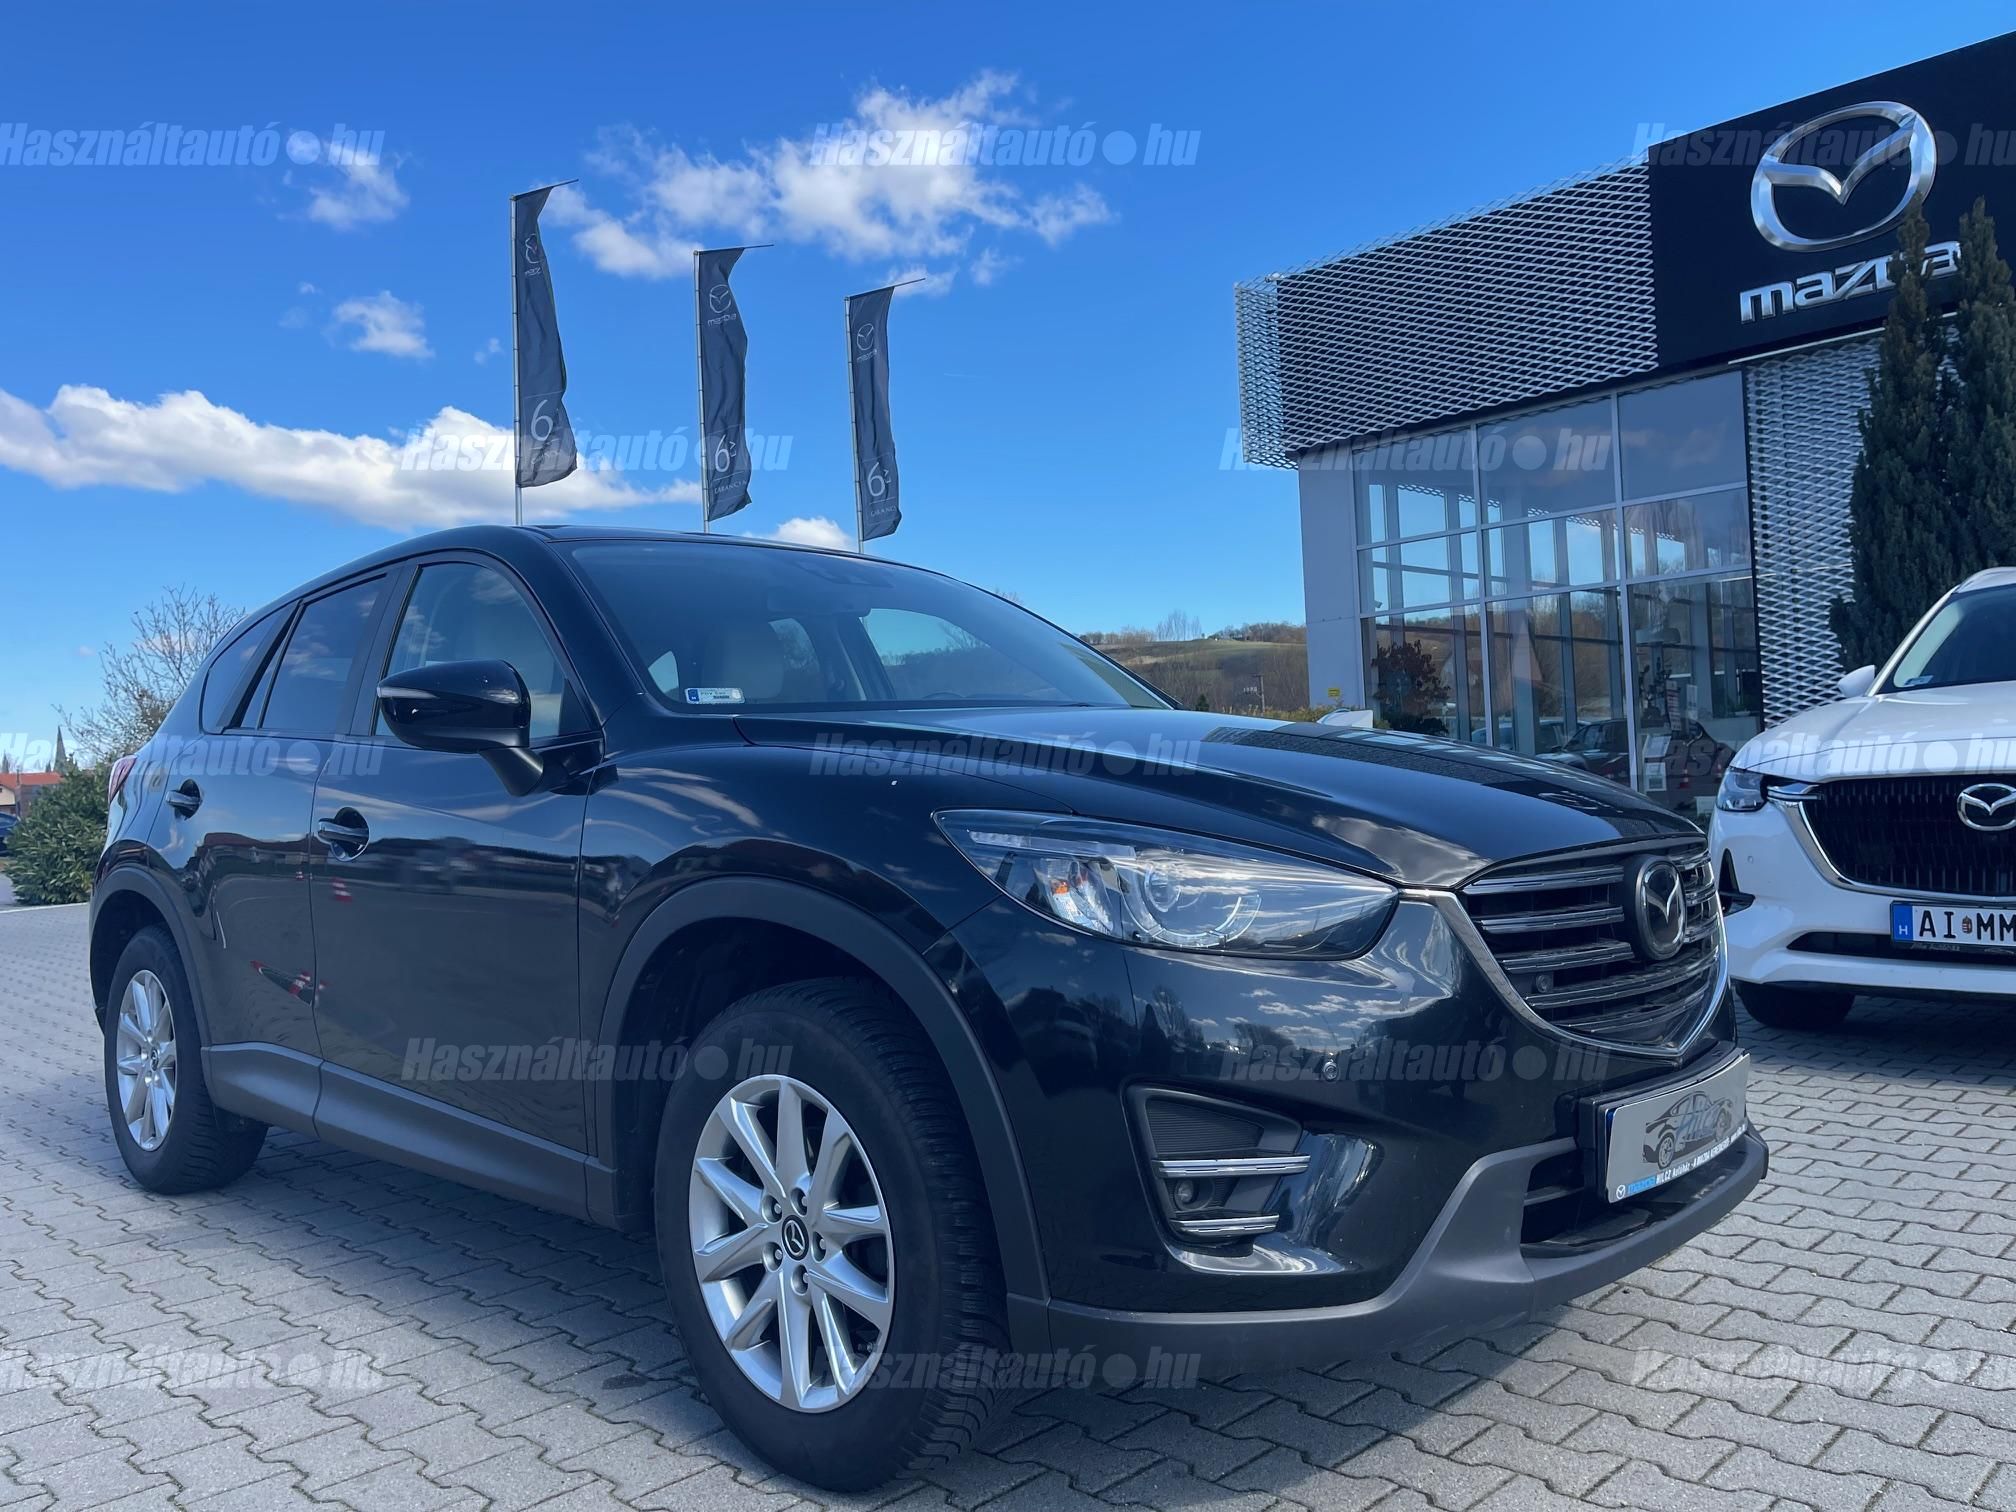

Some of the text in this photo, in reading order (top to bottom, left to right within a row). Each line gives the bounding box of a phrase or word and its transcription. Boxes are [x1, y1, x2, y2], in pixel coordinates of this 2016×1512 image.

[531, 399, 553, 441] 6
[715, 434, 730, 473] 6
[867, 462, 885, 497] 6
